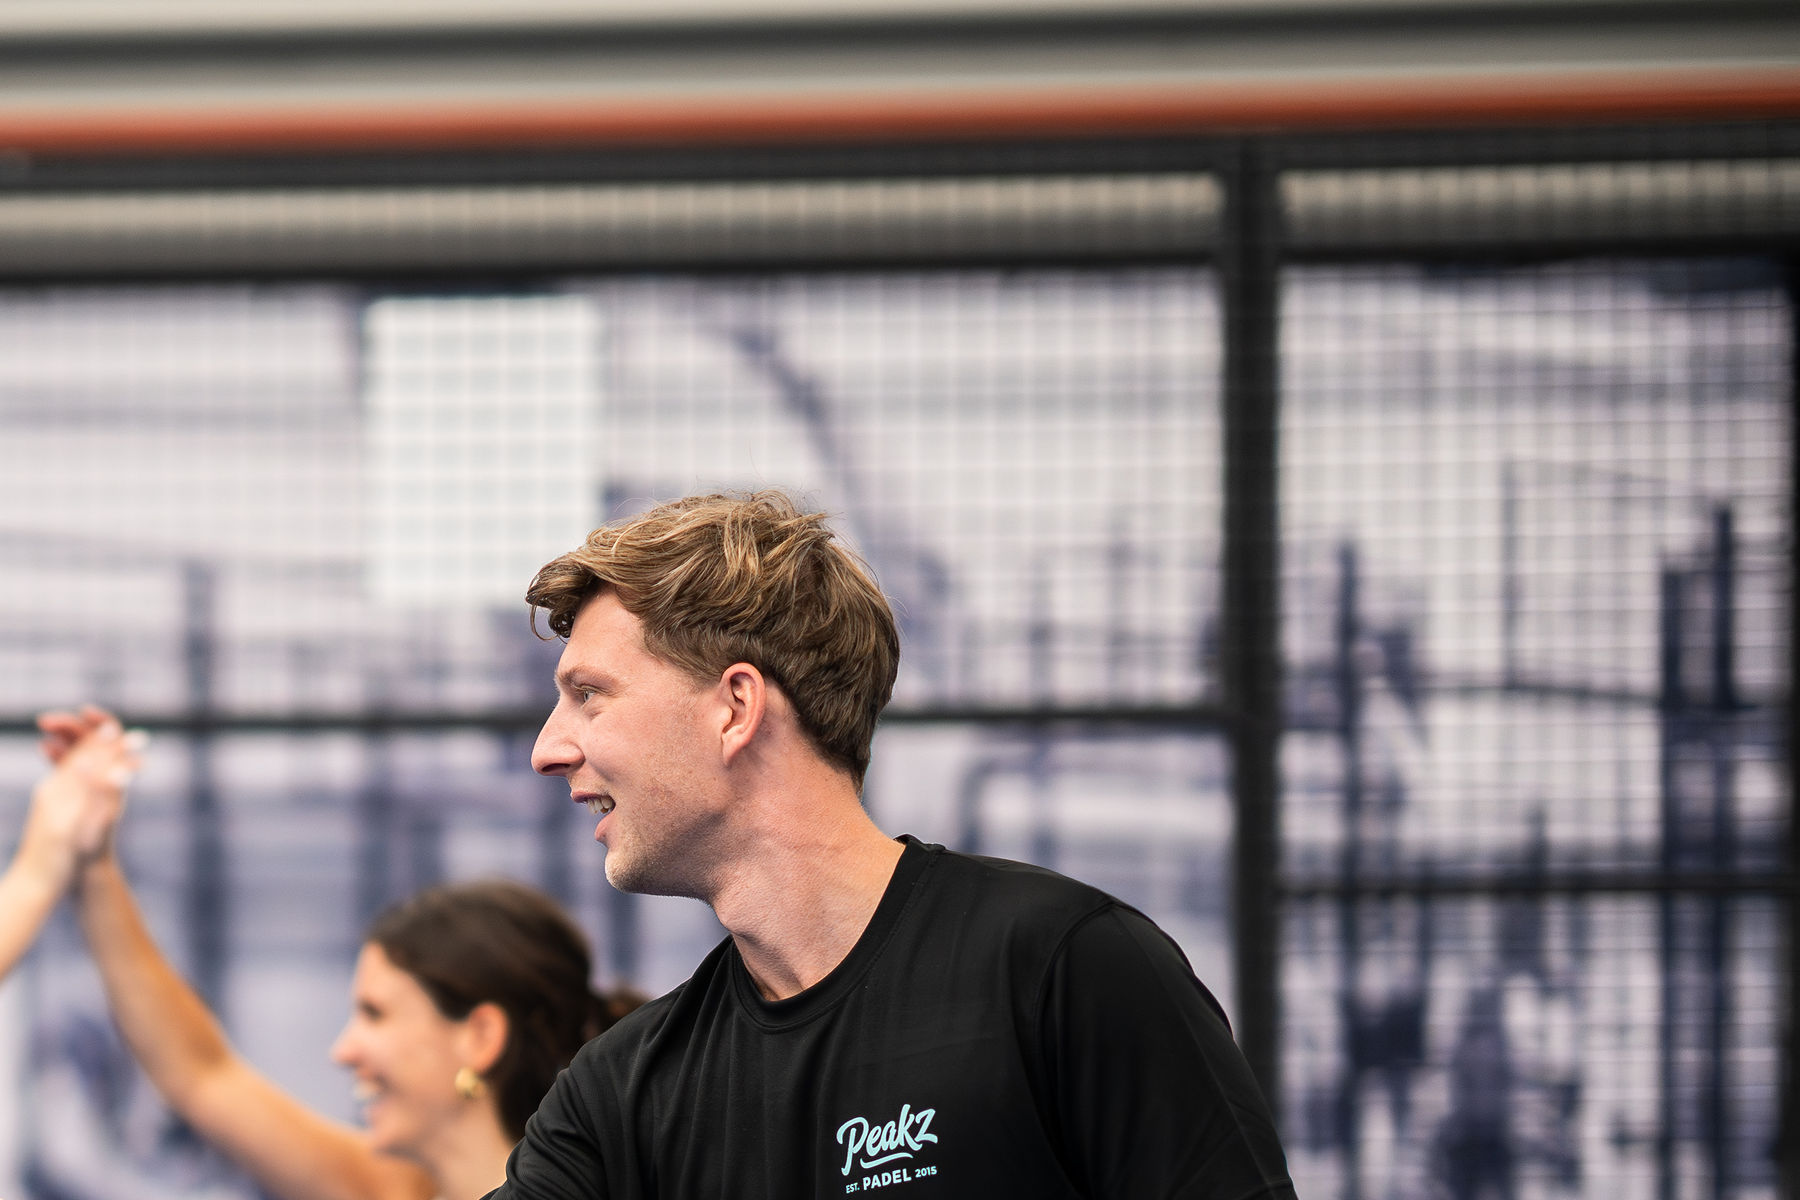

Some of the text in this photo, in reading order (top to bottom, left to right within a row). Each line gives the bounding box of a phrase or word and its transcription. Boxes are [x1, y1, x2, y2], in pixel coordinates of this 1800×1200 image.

[836, 1104, 938, 1176] Peakz
[863, 1169, 911, 1190] PADEL
[915, 1166, 937, 1177] 2015
